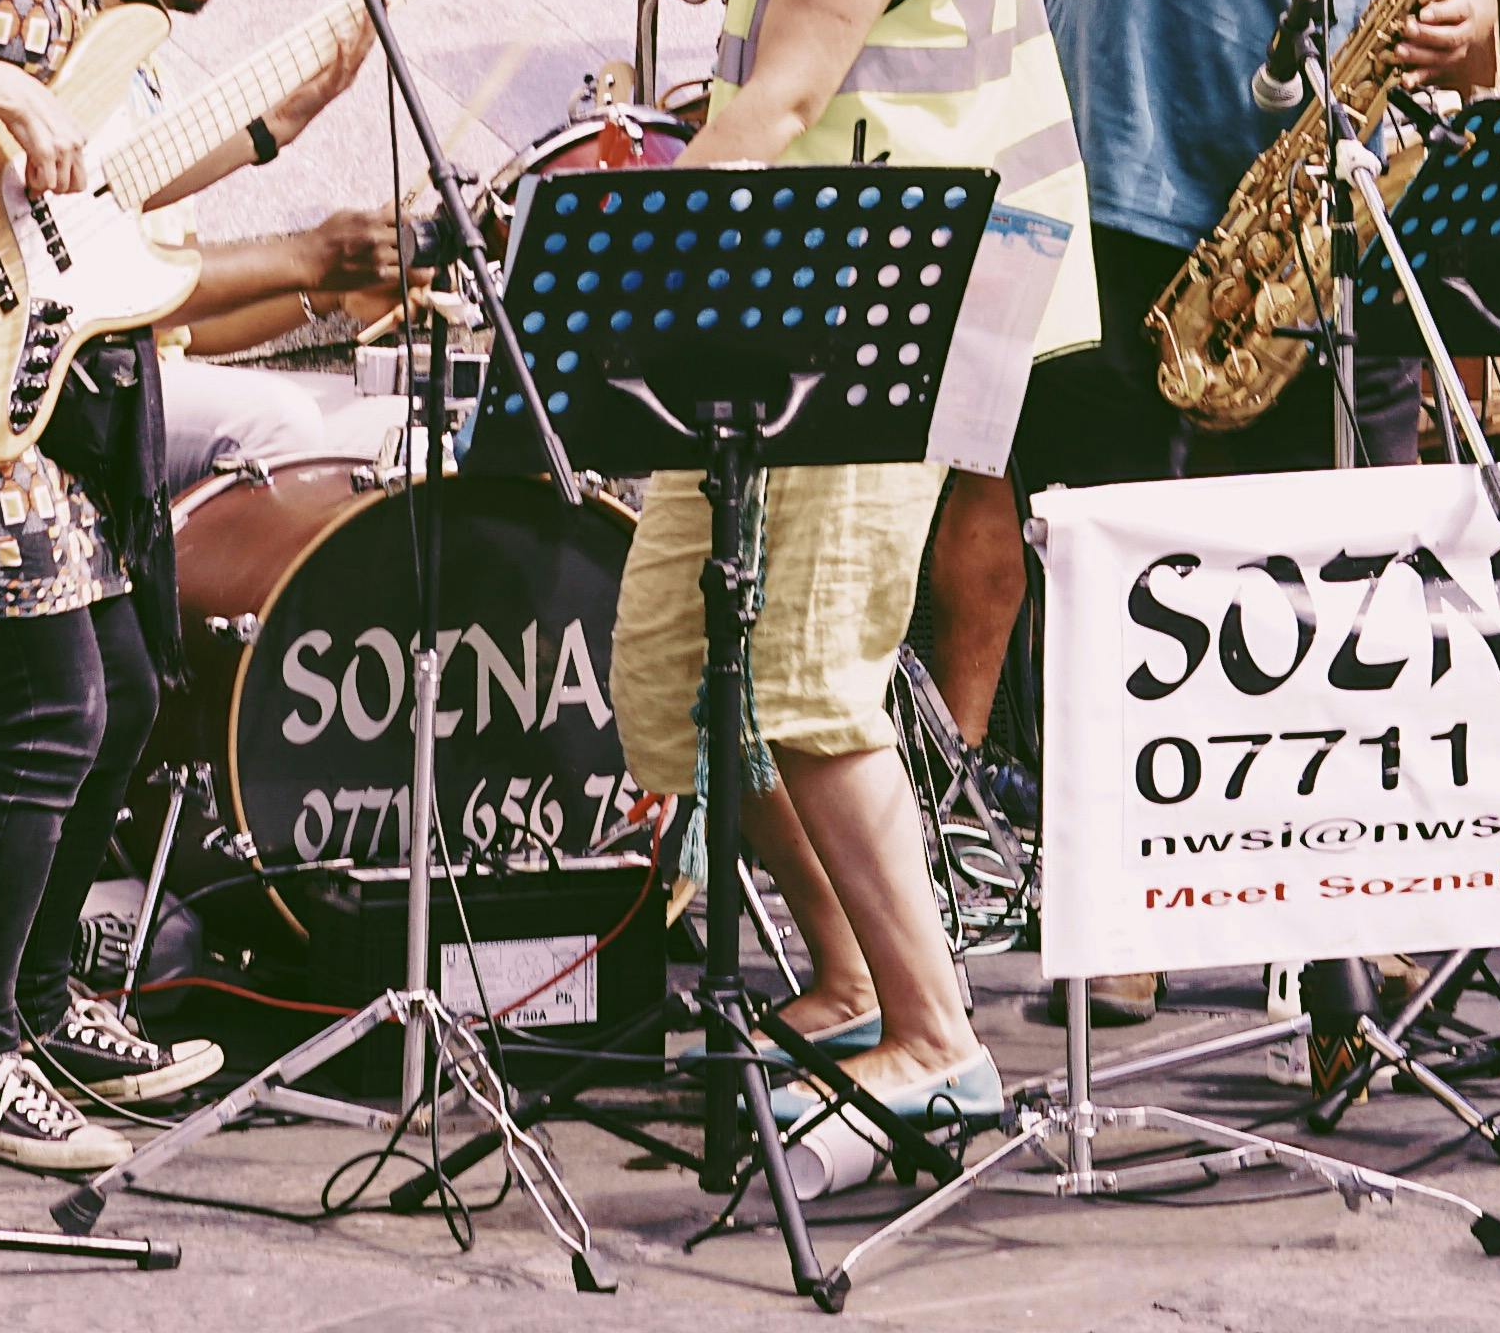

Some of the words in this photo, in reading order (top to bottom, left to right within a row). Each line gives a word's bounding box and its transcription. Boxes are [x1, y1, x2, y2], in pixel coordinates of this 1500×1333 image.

[282, 618, 614, 744] SOZNA
[1135, 721, 1468, 805] 07711
[294, 785, 435, 862] 0771
[463, 775, 564, 853] 656
[1146, 880, 1289, 910] Meet
